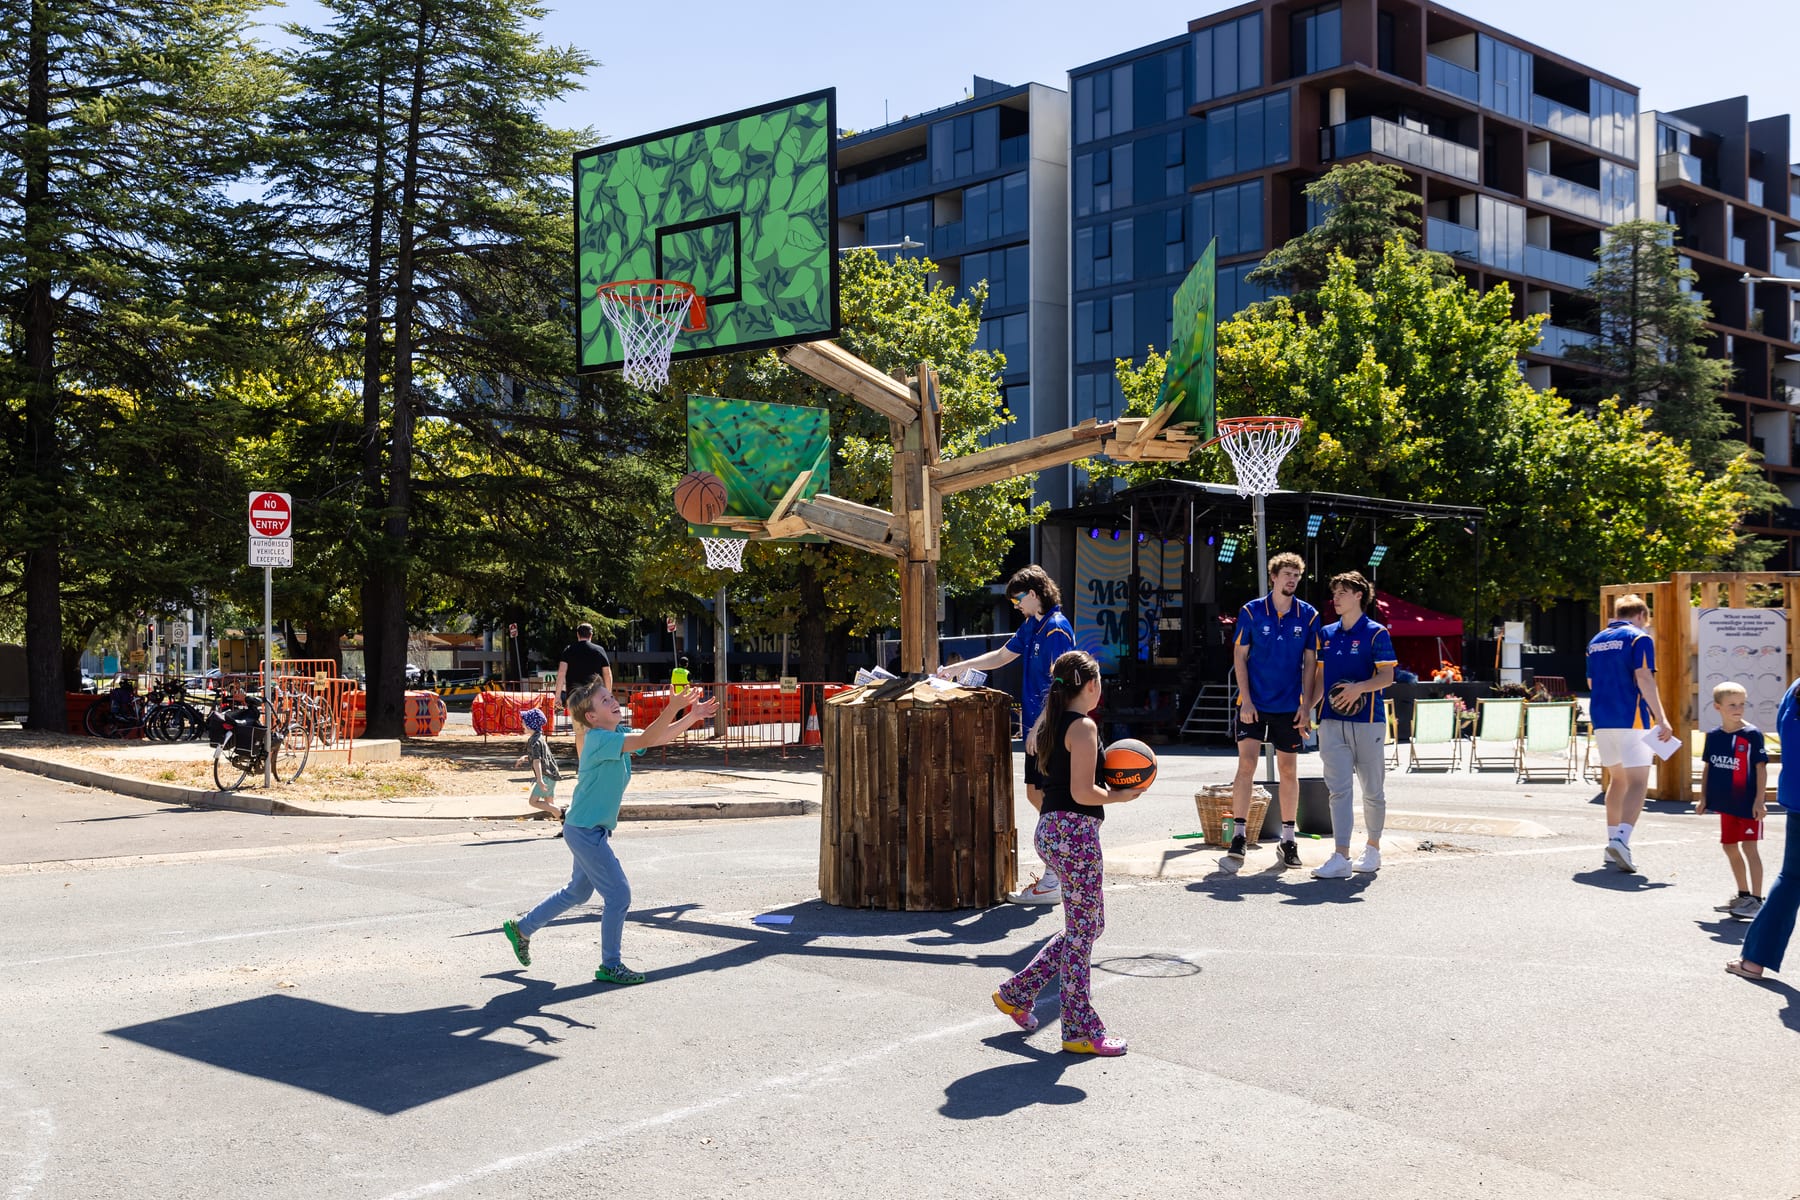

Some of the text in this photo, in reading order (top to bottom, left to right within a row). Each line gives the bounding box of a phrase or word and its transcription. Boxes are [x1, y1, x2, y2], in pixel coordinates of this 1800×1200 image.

[263, 499, 277, 509] NO
[255, 520, 285, 530] ENTRY
[1710, 754, 1741, 767] QATAR
